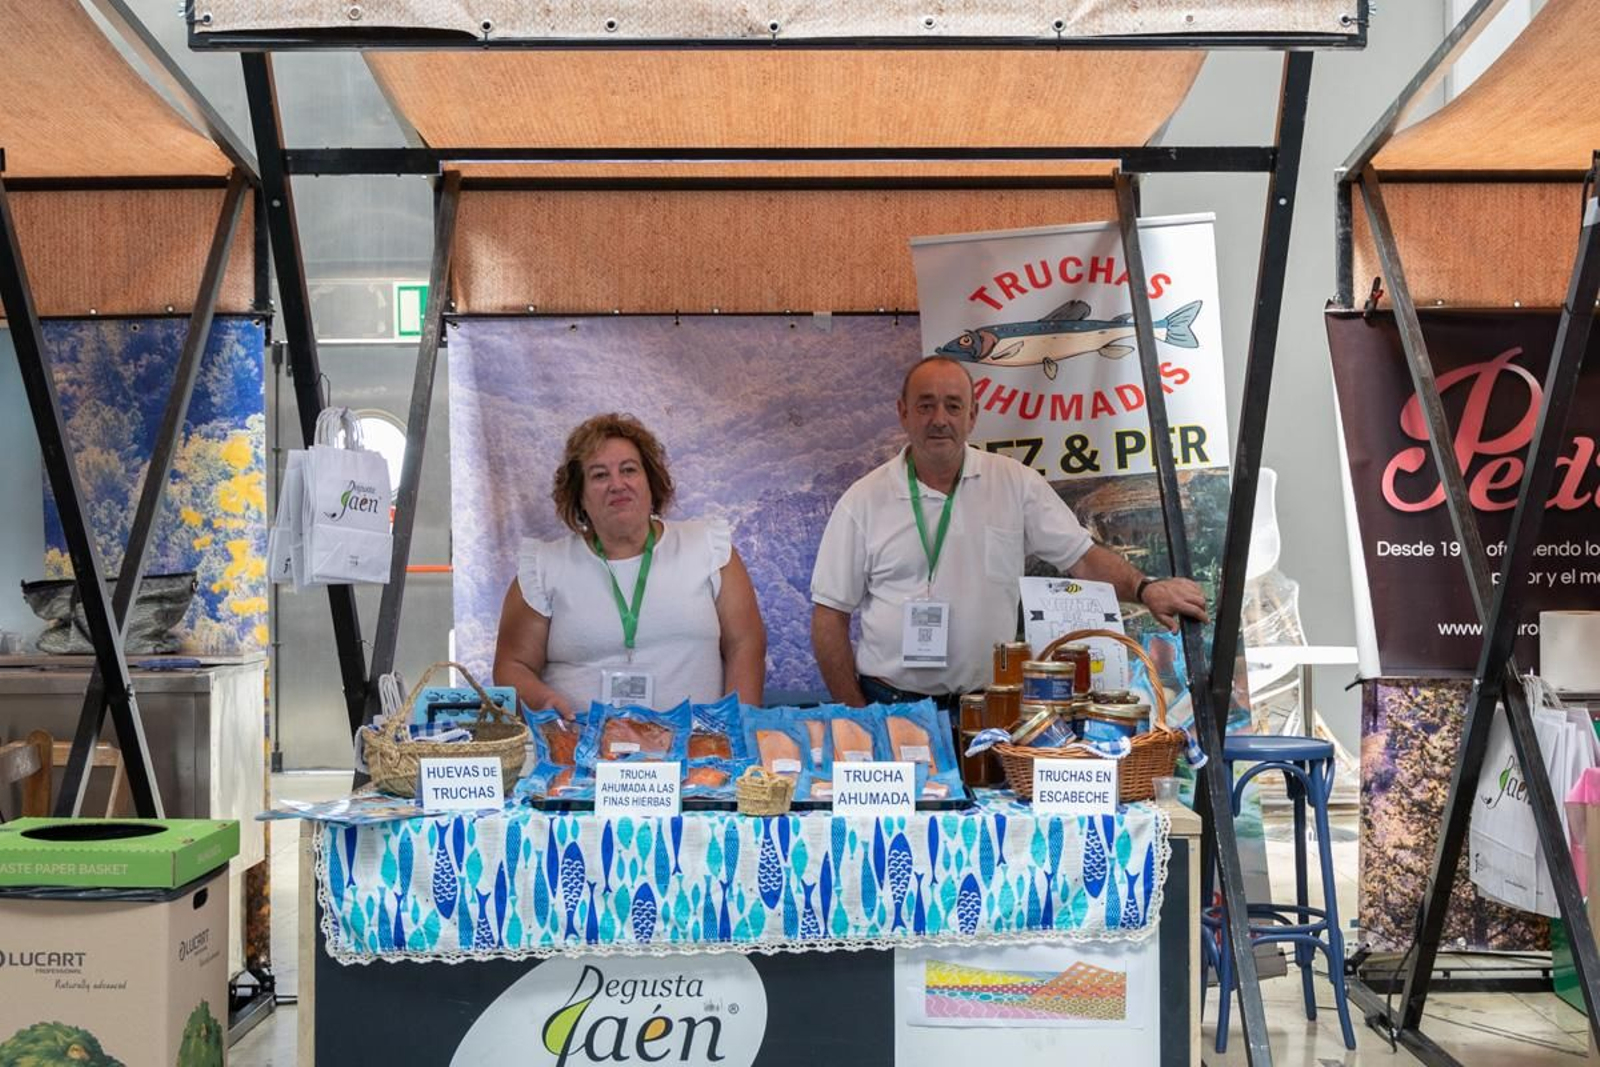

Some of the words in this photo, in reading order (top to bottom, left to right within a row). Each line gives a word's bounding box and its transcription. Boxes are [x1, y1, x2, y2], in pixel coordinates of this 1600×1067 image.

[974, 362, 1190, 421] AHUMADS
[1060, 433, 1101, 475] &
[1377, 541, 1435, 557] Desde
[1546, 572, 1557, 588] y
[1560, 568, 1576, 584] el
[427, 765, 479, 779] HUEVAS
[483, 766, 497, 778] DE
[620, 769, 657, 779] TRUCHA
[844, 770, 903, 782] TRUCHA
[1038, 770, 1093, 782] TRUCHAS
[1096, 771, 1111, 782] EN
[432, 786, 495, 800] TRUCHAS
[601, 783, 646, 793] AHUMADA
[648, 783, 654, 793] A
[657, 784, 674, 794] LAS
[603, 796, 629, 806] FINAS
[632, 796, 671, 807] HIERBAS
[837, 791, 910, 805] AHUMADA
[1039, 791, 1109, 803] ESCABECHE
[35, 863, 75, 875] PAPER
[79, 864, 128, 875] BASKET
[9, 952, 86, 967] LUCART
[565, 964, 704, 1004] Degusta
[542, 999, 726, 1067] Jaén
